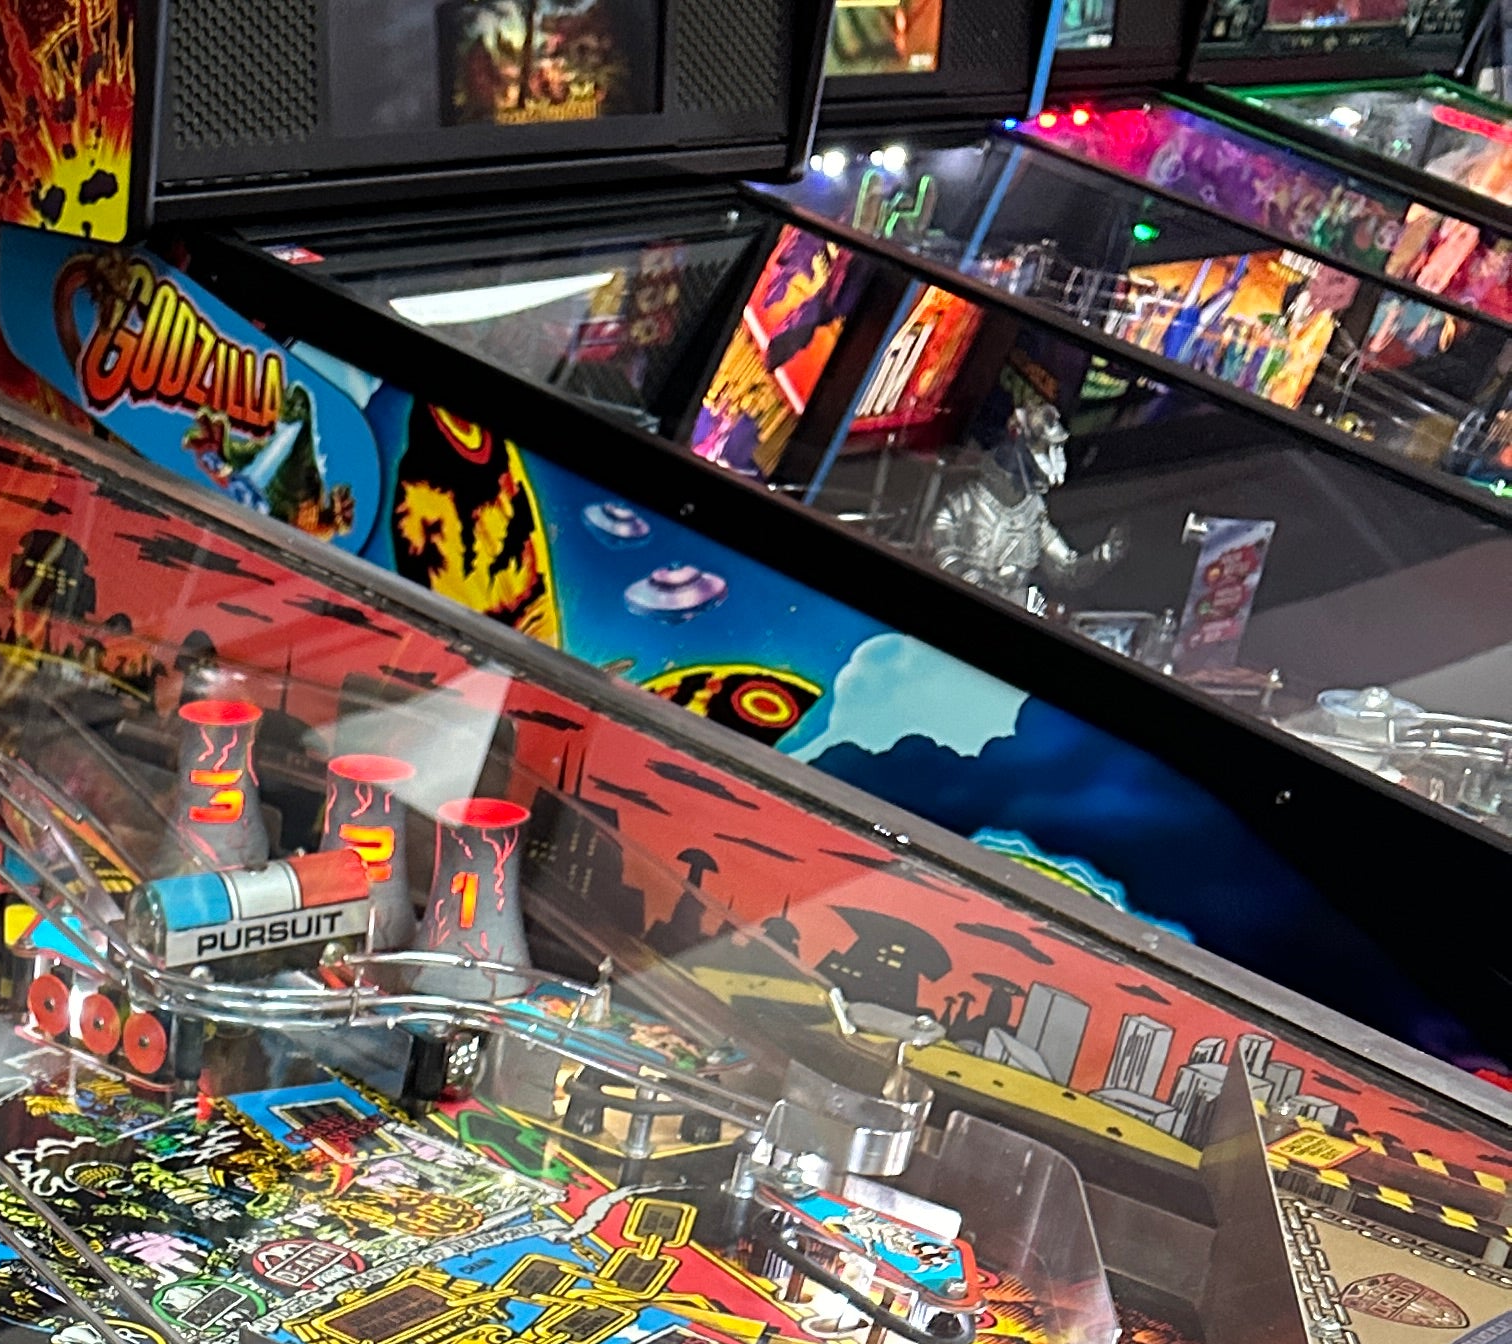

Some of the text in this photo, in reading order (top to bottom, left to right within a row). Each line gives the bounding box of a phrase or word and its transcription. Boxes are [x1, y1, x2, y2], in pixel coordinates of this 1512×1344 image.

[81, 261, 287, 430] GODZILLA
[189, 769, 245, 823] 3
[339, 823, 395, 882] 2
[451, 871, 480, 929] 1
[196, 911, 343, 957] PURSUIT
[276, 1247, 337, 1283] DEATH
